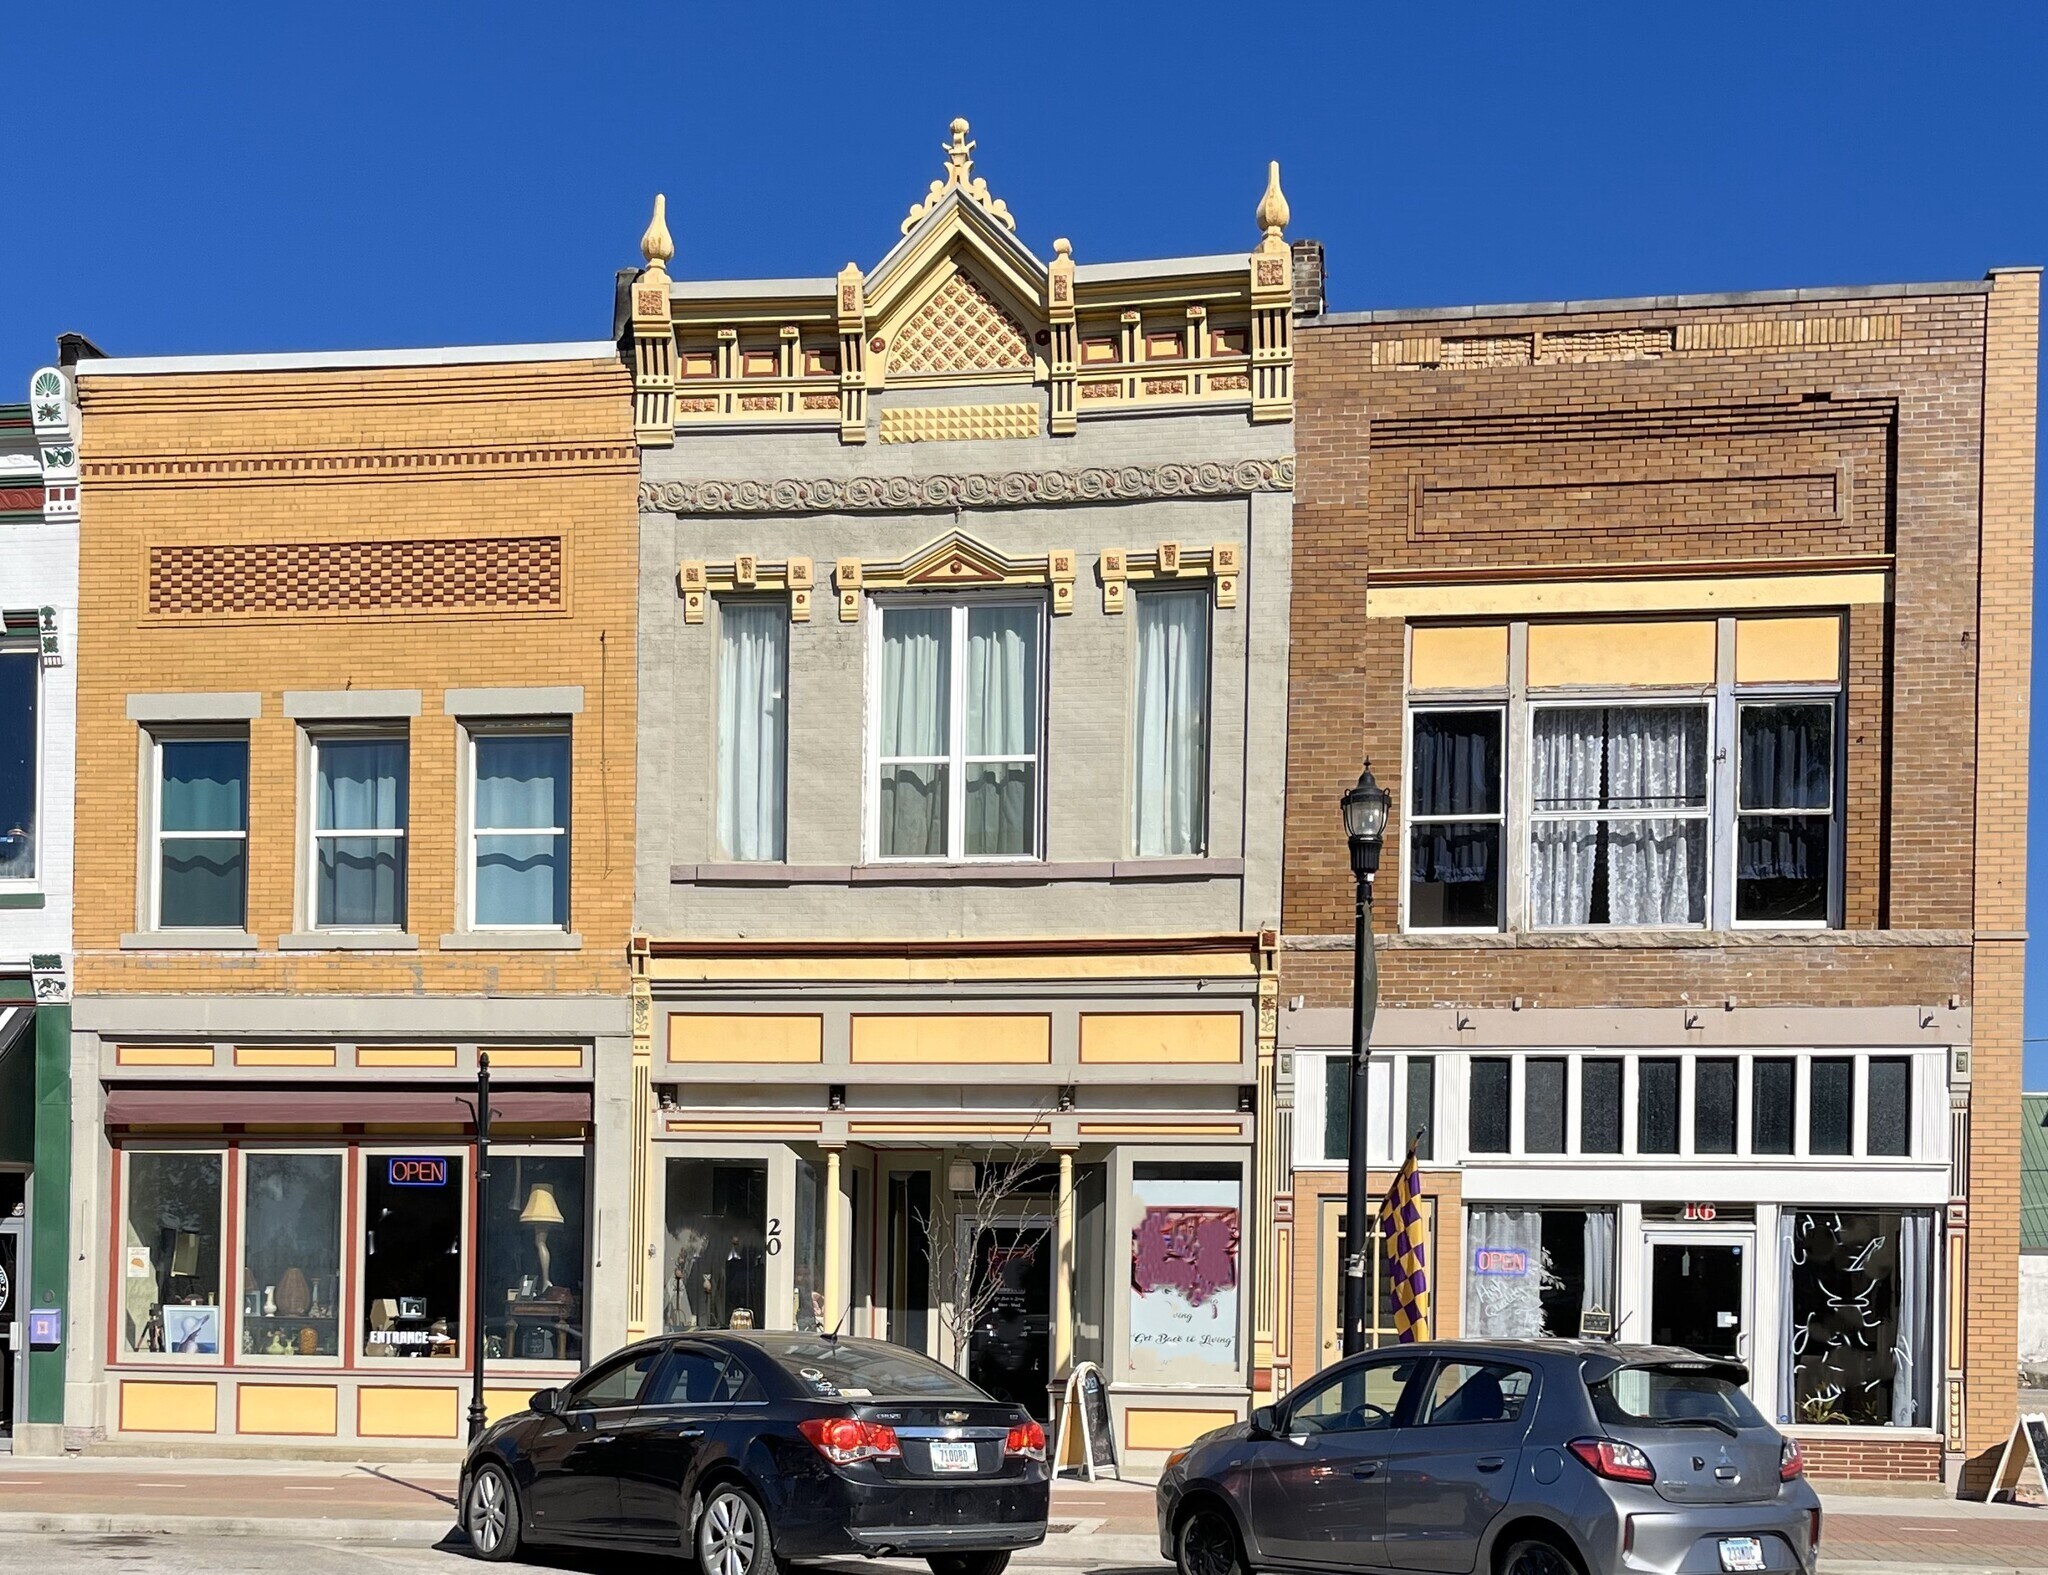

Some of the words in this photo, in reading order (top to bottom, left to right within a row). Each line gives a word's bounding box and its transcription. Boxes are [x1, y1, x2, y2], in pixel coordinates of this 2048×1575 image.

[392, 1161, 444, 1181] OPEN
[1684, 1202, 1716, 1220] 16
[767, 1218, 782, 1256] 20
[1478, 1251, 1526, 1271] OPEN
[370, 1330, 429, 1345] ENTRANCE
